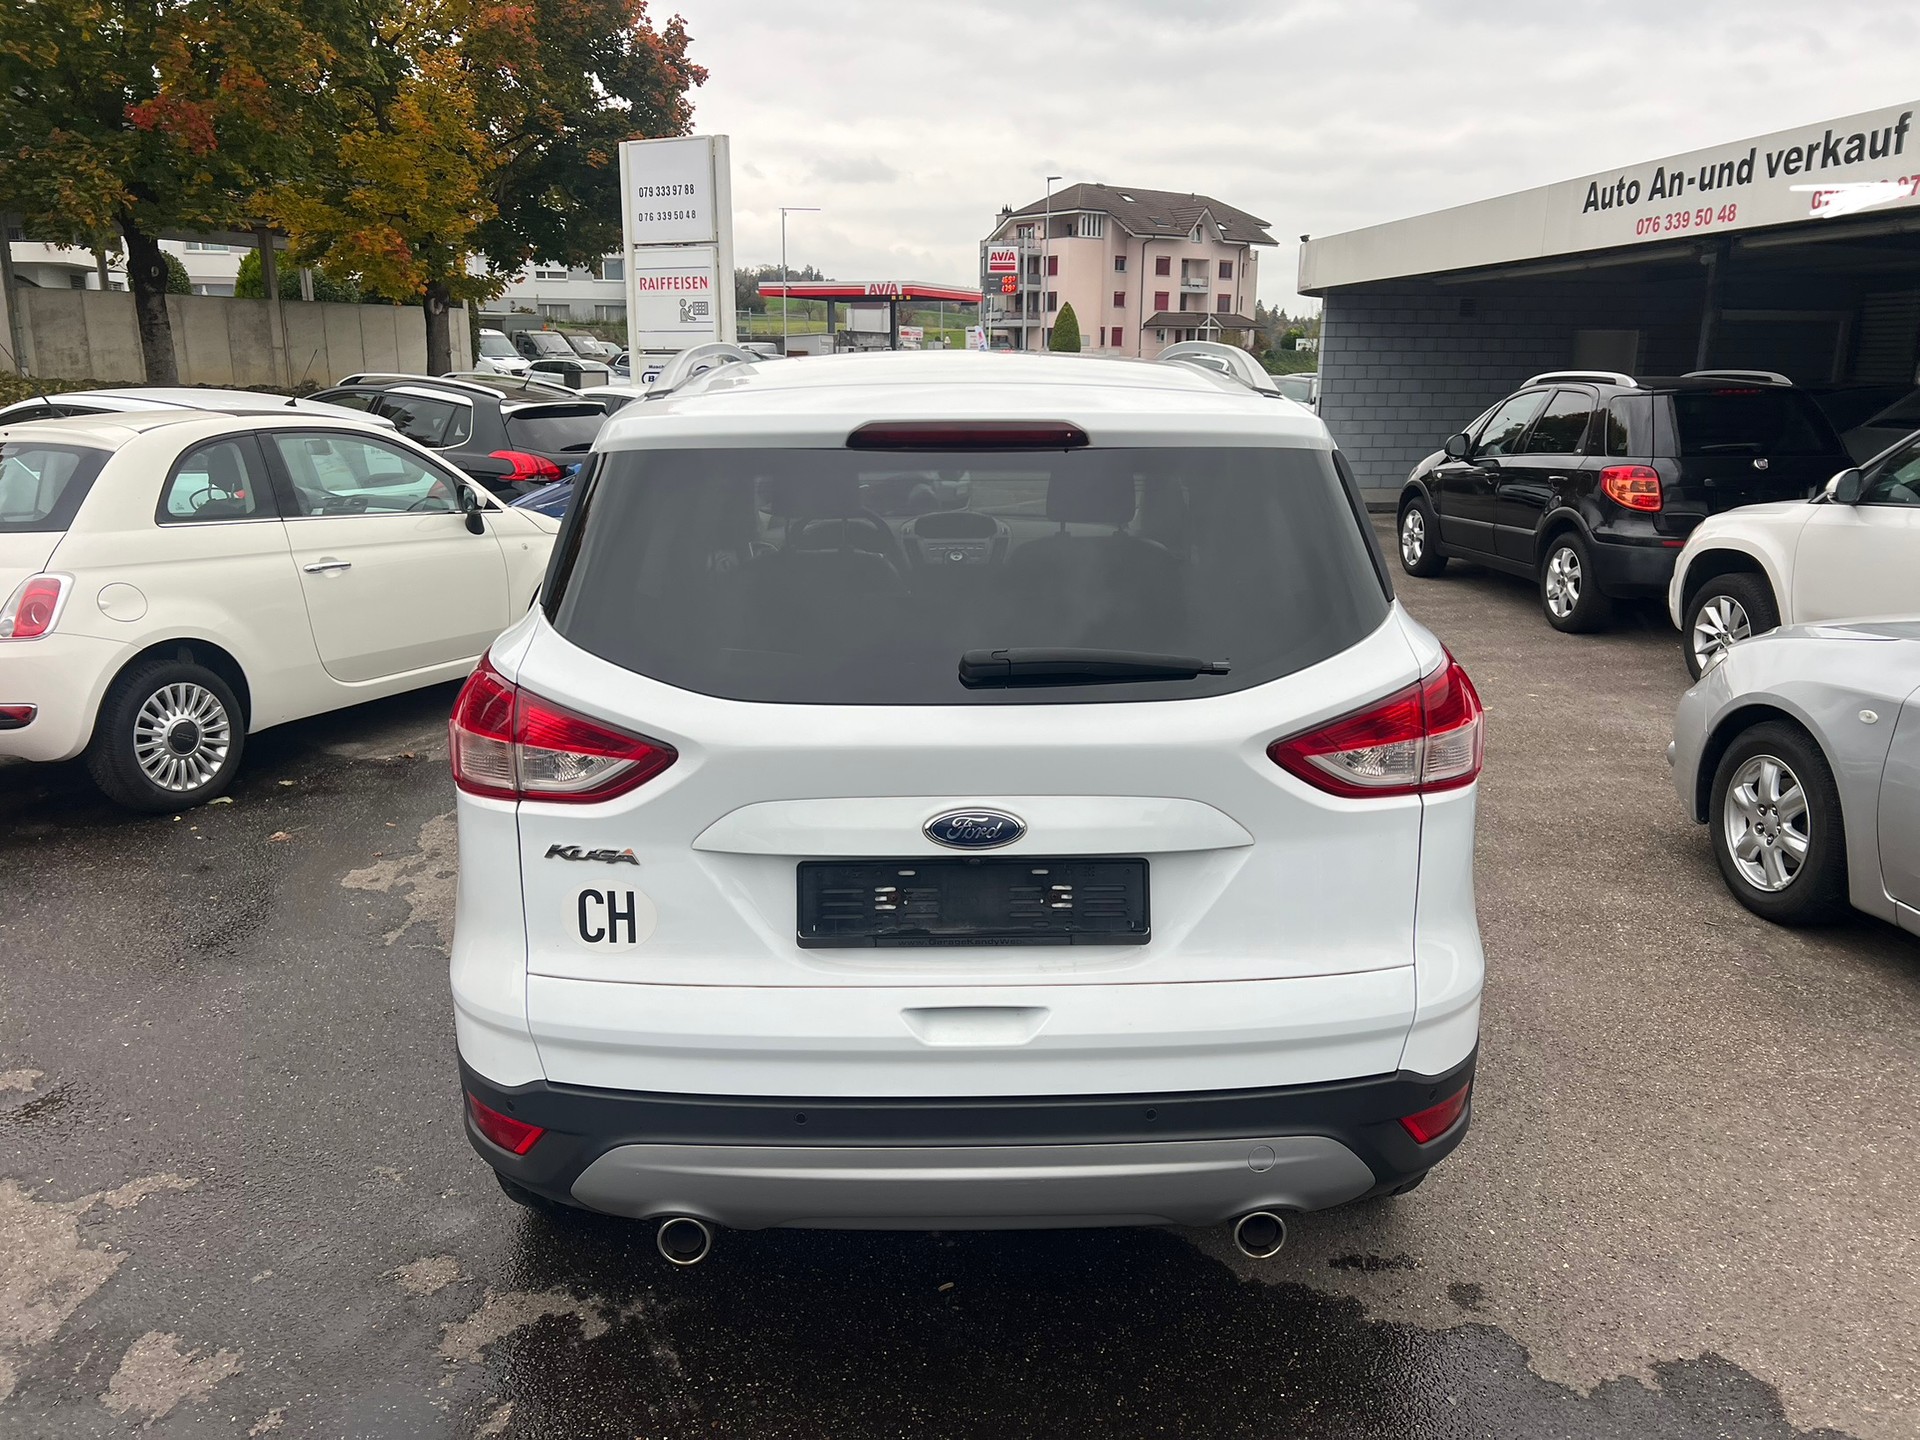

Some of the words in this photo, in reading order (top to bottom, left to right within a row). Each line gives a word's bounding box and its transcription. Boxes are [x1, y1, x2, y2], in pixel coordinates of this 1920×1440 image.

[1582, 175, 1641, 214] Auto
[1647, 146, 1757, 202] An-und
[1765, 110, 1914, 179] verkauf
[638, 186, 654, 198] 079
[655, 185, 671, 197] 333
[672, 184, 683, 196] 97
[684, 183, 695, 195] 88
[638, 212, 654, 222] 076
[656, 211, 672, 221] 339
[673, 210, 684, 220] 50
[685, 209, 697, 219] 48
[1636, 215, 1661, 236] 076
[1664, 210, 1691, 232] 339
[1694, 207, 1713, 227] 50
[1717, 203, 1737, 223] 48
[990, 249, 1016, 261] AVIA
[639, 275, 709, 291] RAIFFEISEN
[868, 280, 899, 296] AVIA
[945, 815, 1004, 840] Ford
[543, 843, 641, 867] KUGA
[577, 888, 637, 944] CH
